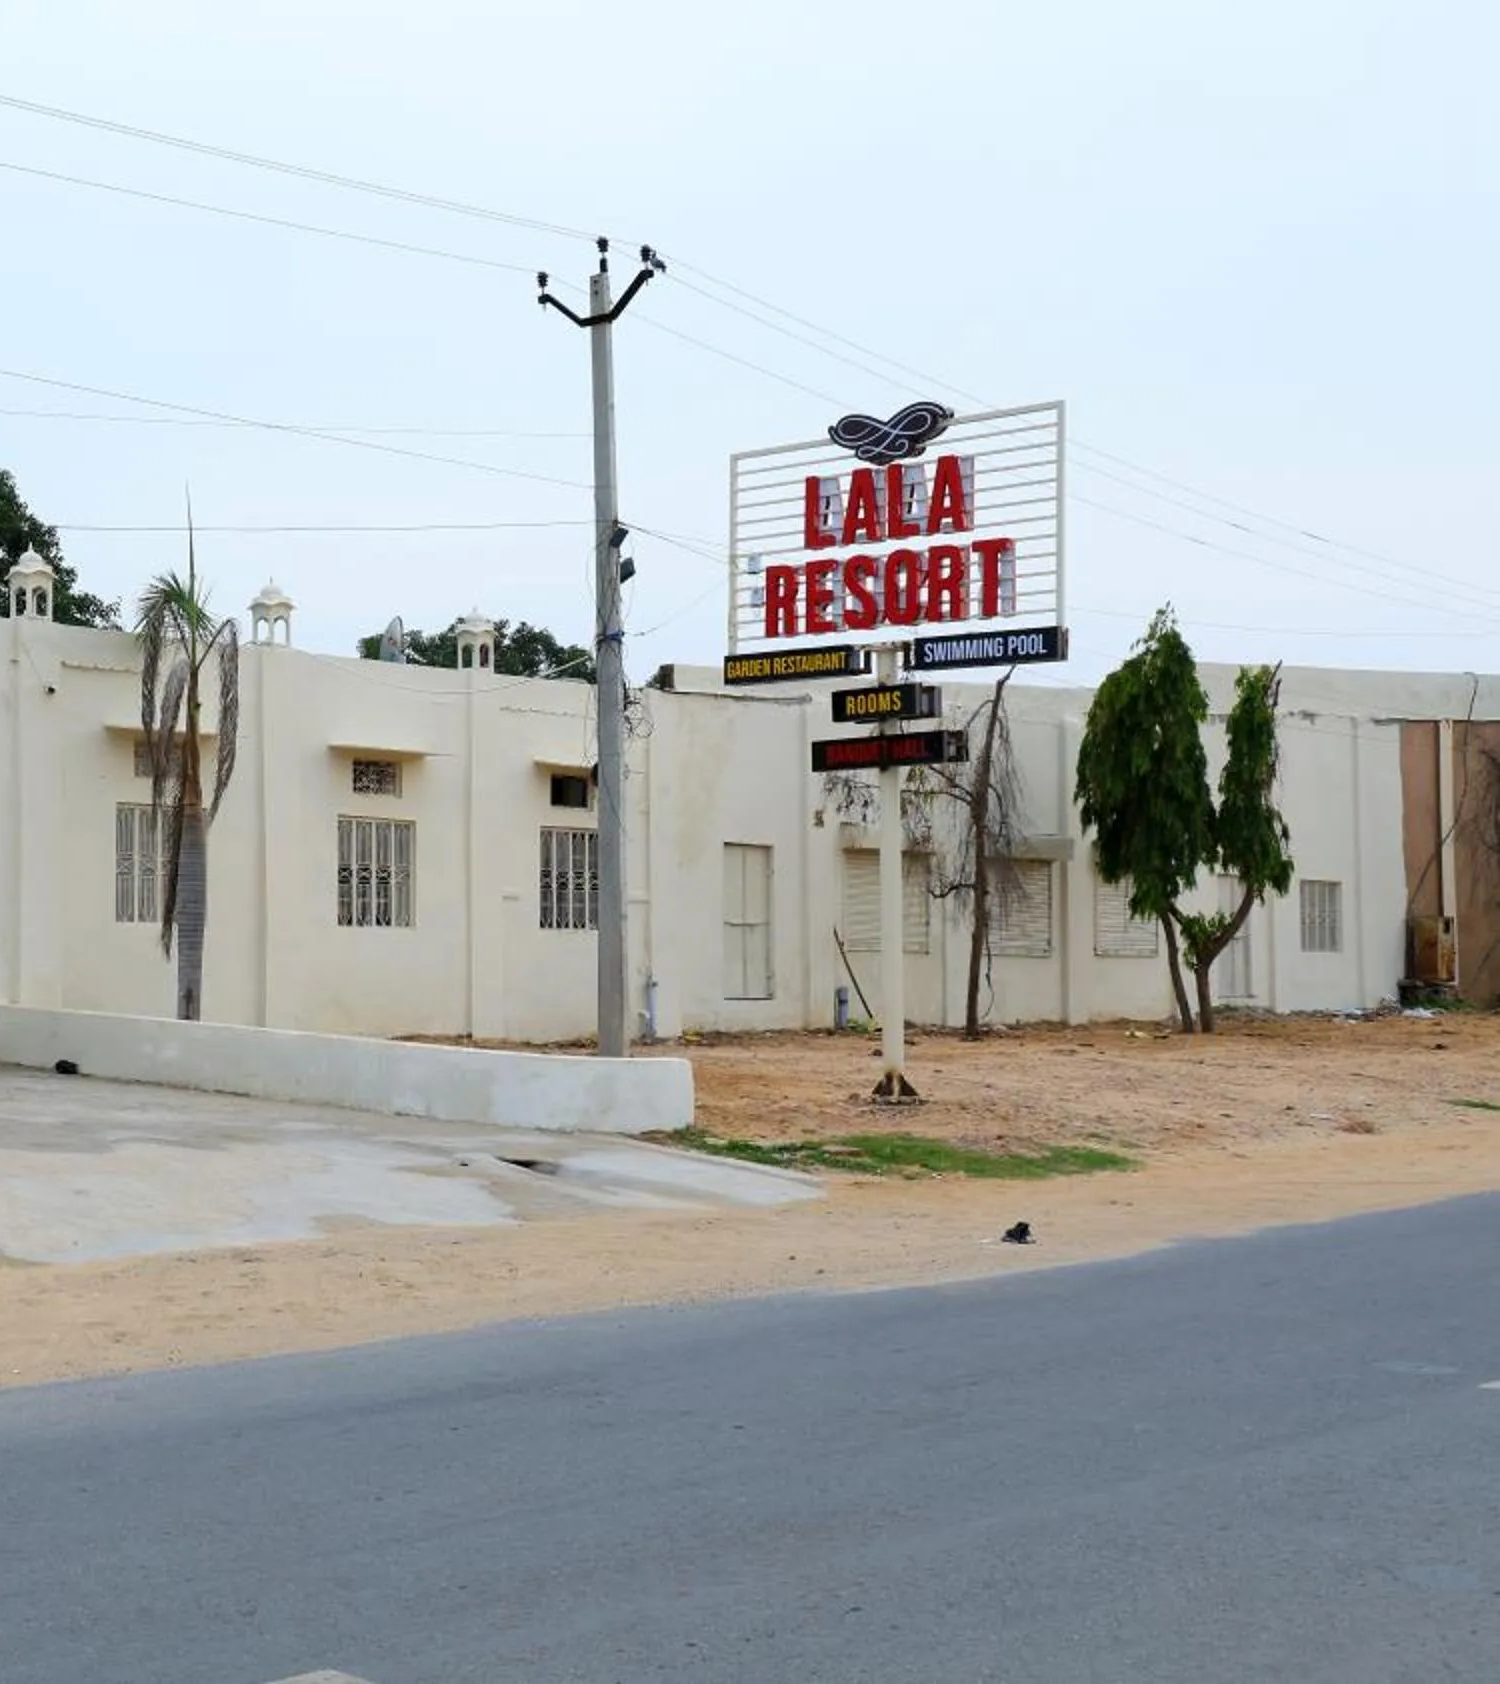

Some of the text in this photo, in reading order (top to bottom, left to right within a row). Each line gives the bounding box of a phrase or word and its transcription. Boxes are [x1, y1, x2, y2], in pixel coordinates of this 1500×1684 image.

[804, 455, 974, 551] LALA
[765, 537, 1016, 638] RESORT
[923, 633, 1047, 663] SWIMMING POOL
[727, 651, 846, 678] GARDEN RESTAURANT
[846, 690, 901, 716] ROOMS
